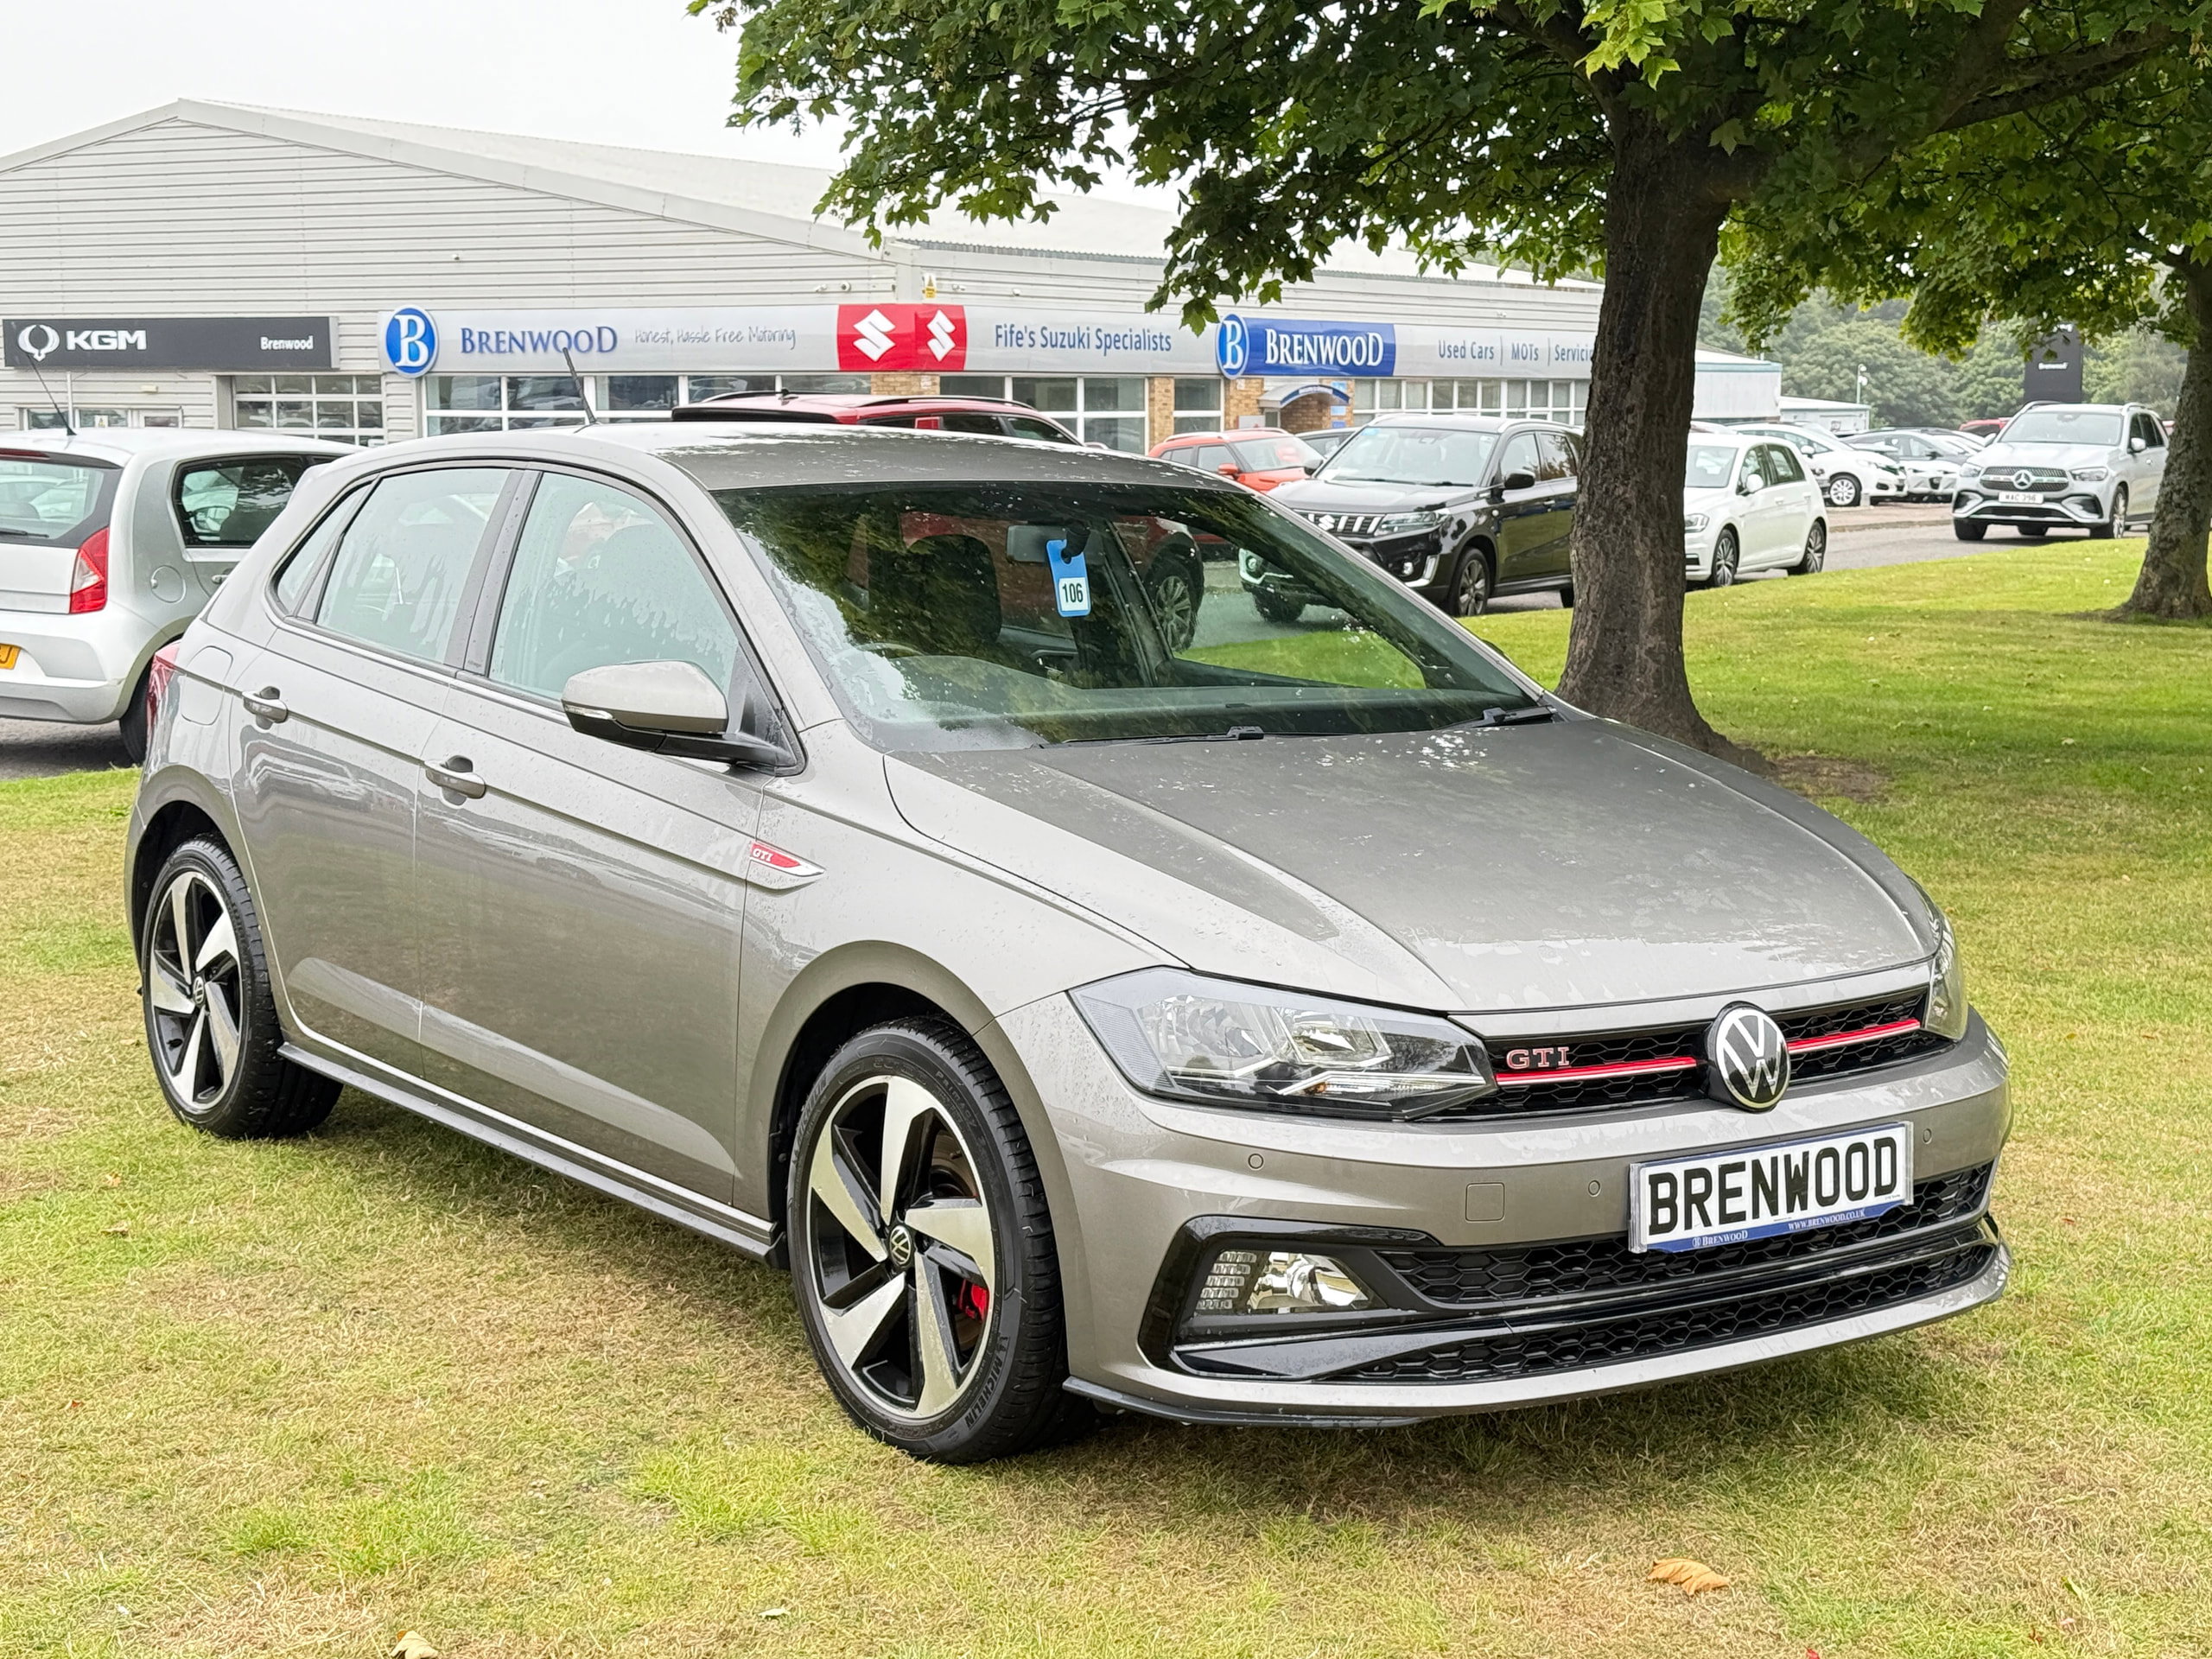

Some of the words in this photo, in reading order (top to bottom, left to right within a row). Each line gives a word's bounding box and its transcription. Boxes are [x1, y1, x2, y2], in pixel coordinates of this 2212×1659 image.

[66, 330, 147, 350] KGM
[261, 335, 314, 350] Brenwood
[394, 315, 429, 367] B
[461, 326, 618, 354] BRENWOOD
[635, 327, 673, 345] Honest,
[677, 326, 710, 344] Hassle
[715, 327, 744, 343] Free
[748, 326, 796, 350] Motoring
[995, 324, 1035, 347] Fife's
[1040, 326, 1090, 349] Suzuki
[1095, 328, 1172, 356] Specialists
[1223, 321, 1243, 369] B
[1265, 328, 1383, 366] BRENWOOD
[1438, 340, 1466, 359] Used
[1471, 341, 1495, 359] Cars
[1511, 343, 1539, 361] MOTs
[1062, 583, 1084, 602] 106
[753, 848, 773, 862] GTI
[1506, 1046, 1570, 1070] GTI
[1648, 1135, 1897, 1236] BRENWOOD
[1702, 1230, 1748, 1246] BRENWOOD
[964, 1354, 1003, 1428] MICHELIN
